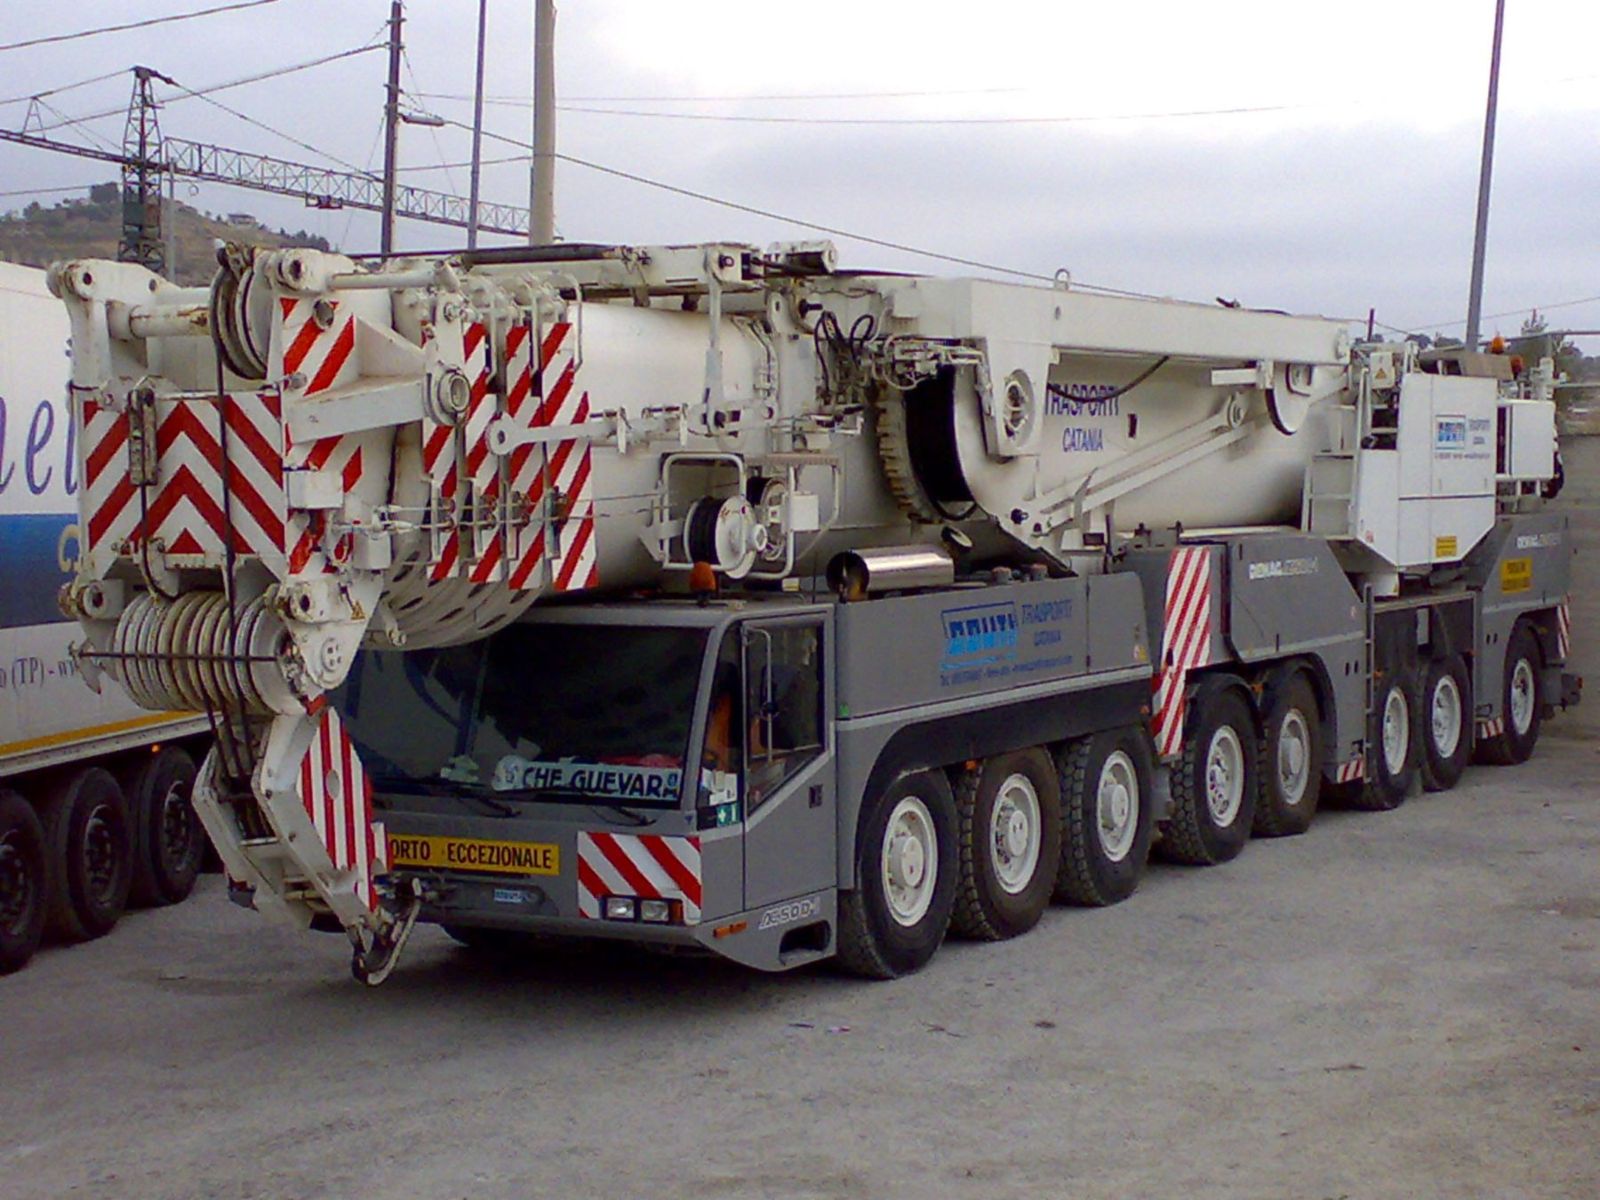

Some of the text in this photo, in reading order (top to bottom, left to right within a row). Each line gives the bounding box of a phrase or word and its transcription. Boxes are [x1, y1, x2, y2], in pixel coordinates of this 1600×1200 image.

[522, 766, 562, 790] CHE
[390, 838, 552, 869] ORTO ECCEZIONALE
